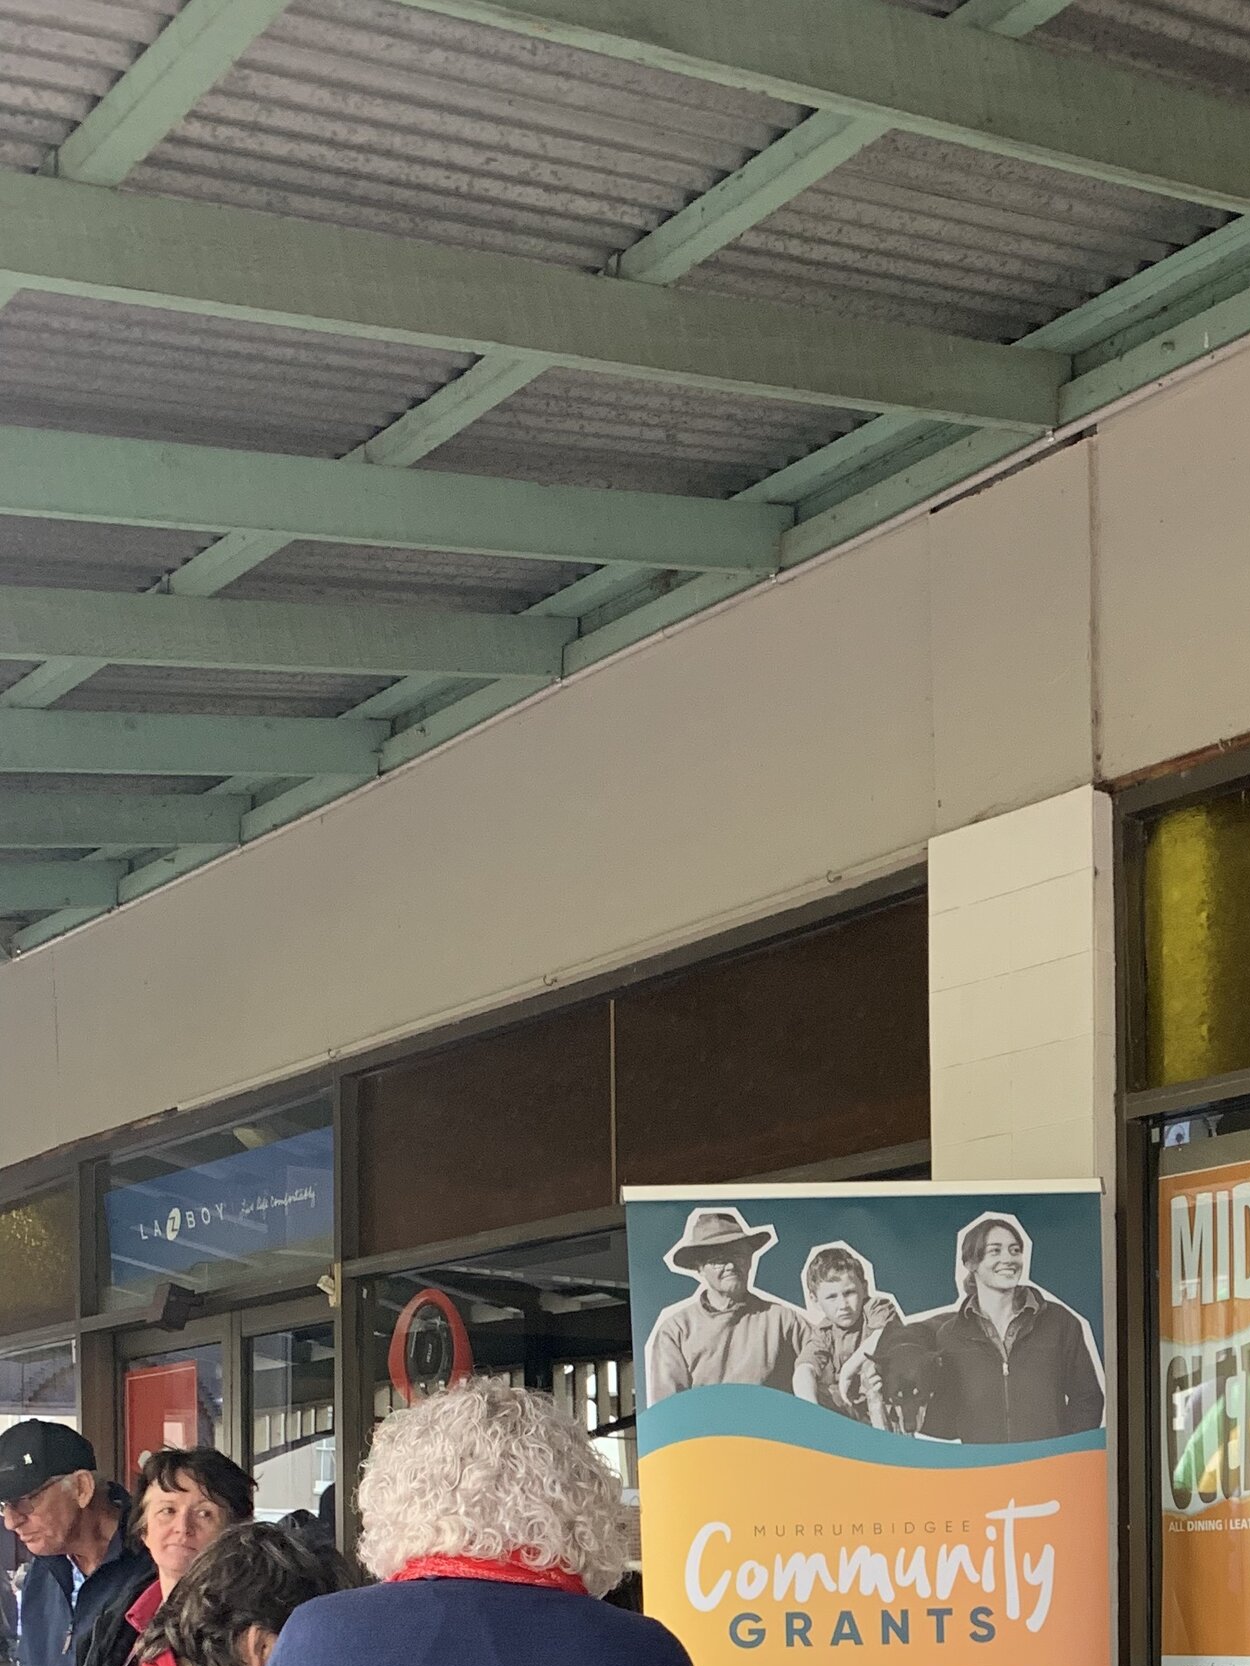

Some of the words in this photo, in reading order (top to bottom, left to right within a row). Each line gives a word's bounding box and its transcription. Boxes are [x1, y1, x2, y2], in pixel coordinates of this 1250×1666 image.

[753, 1520, 971, 1537] MURRUMBIDGEE
[1168, 1521, 1185, 1533] ALL
[1187, 1519, 1222, 1532] DINING
[684, 1498, 1060, 1633] Community
[729, 1606, 996, 1649] GRANTS
